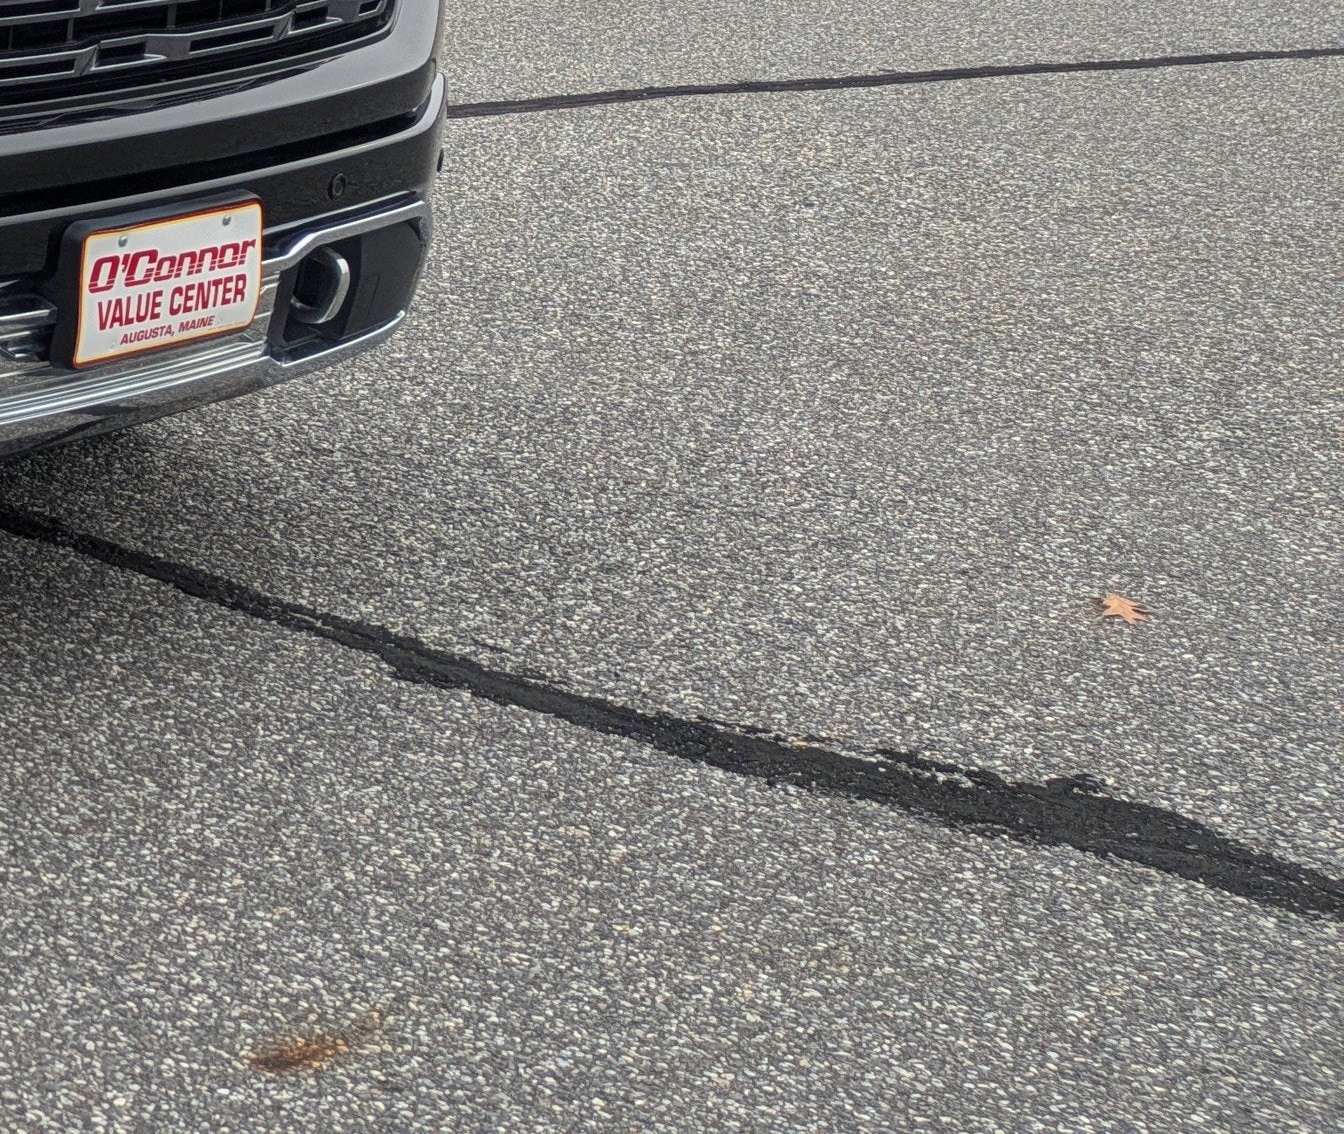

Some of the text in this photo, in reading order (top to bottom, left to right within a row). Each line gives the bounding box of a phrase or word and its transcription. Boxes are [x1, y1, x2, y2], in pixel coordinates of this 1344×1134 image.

[88, 238, 257, 294] O'Connor
[97, 273, 247, 331] VALUE CENTER
[120, 324, 175, 346] AUGUSTA,
[178, 314, 216, 333] MAINE
